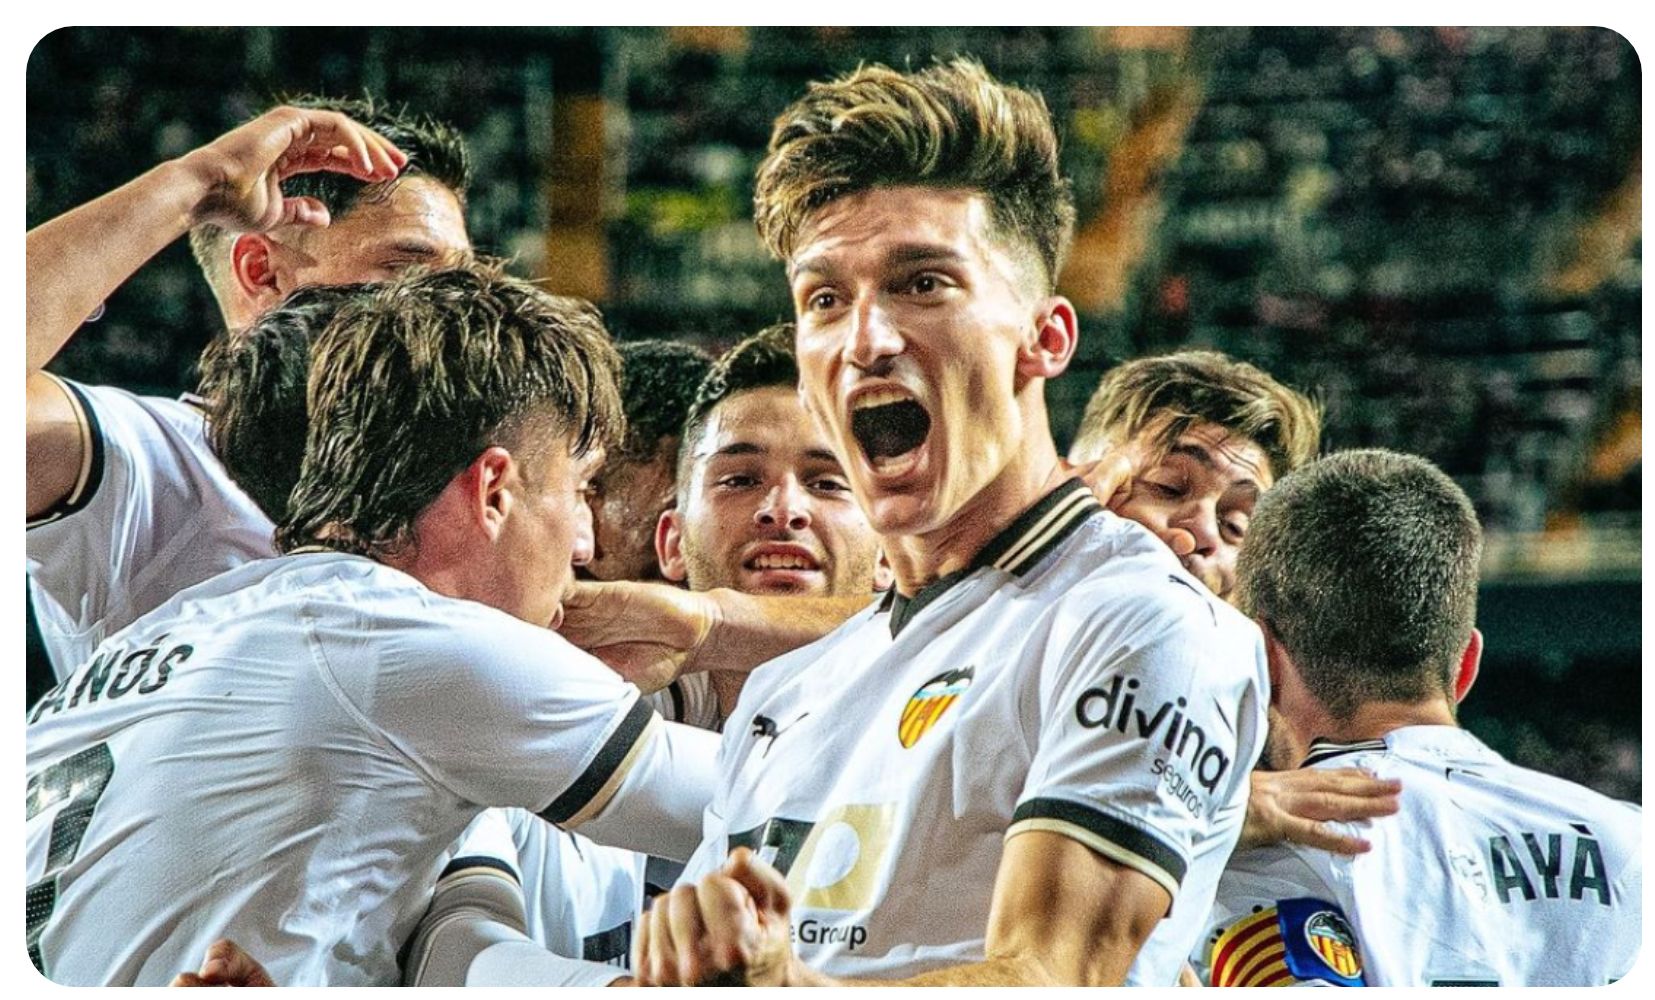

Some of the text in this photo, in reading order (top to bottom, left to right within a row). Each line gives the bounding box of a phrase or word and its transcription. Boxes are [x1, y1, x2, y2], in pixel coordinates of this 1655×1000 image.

[1075, 674, 1230, 795] divina
[1151, 758, 1203, 819] seguros
[1450, 822, 1612, 907] AYÀ
[799, 919, 867, 950] Group
